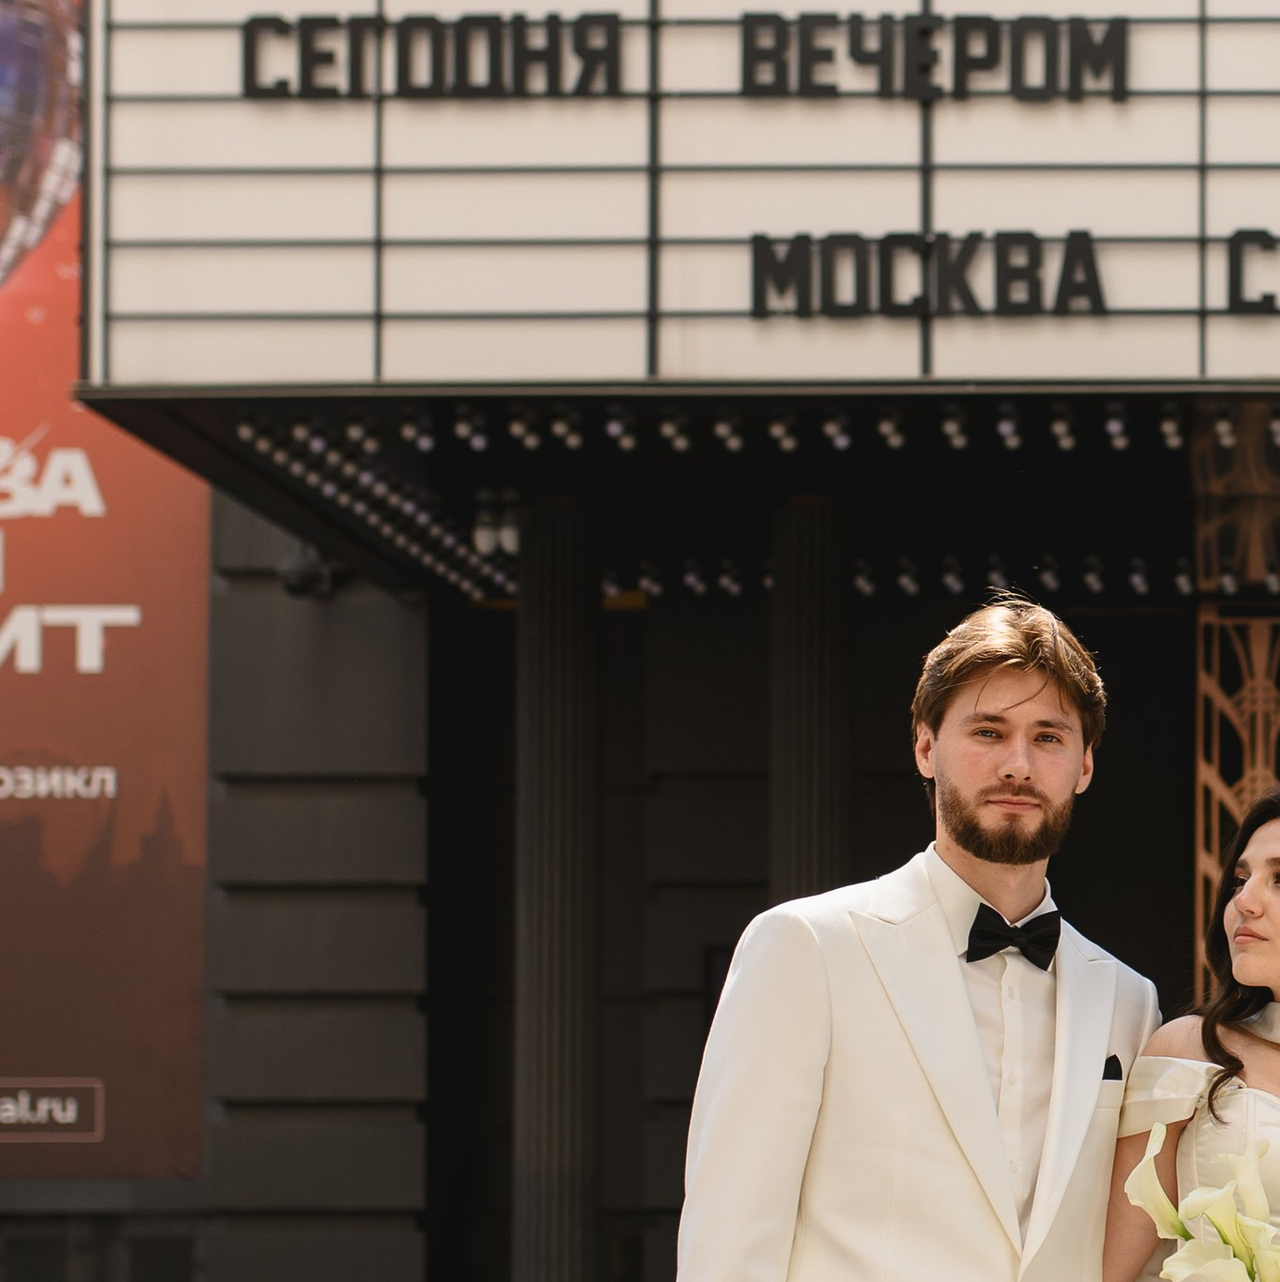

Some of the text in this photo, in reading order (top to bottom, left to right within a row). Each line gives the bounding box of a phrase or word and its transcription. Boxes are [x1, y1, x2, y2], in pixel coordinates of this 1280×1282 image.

[243, 13, 620, 98] СЕГОДНЯ
[742, 13, 1128, 102] ВЕЧЕРОМ
[750, 229, 1107, 317] МОСКВА
